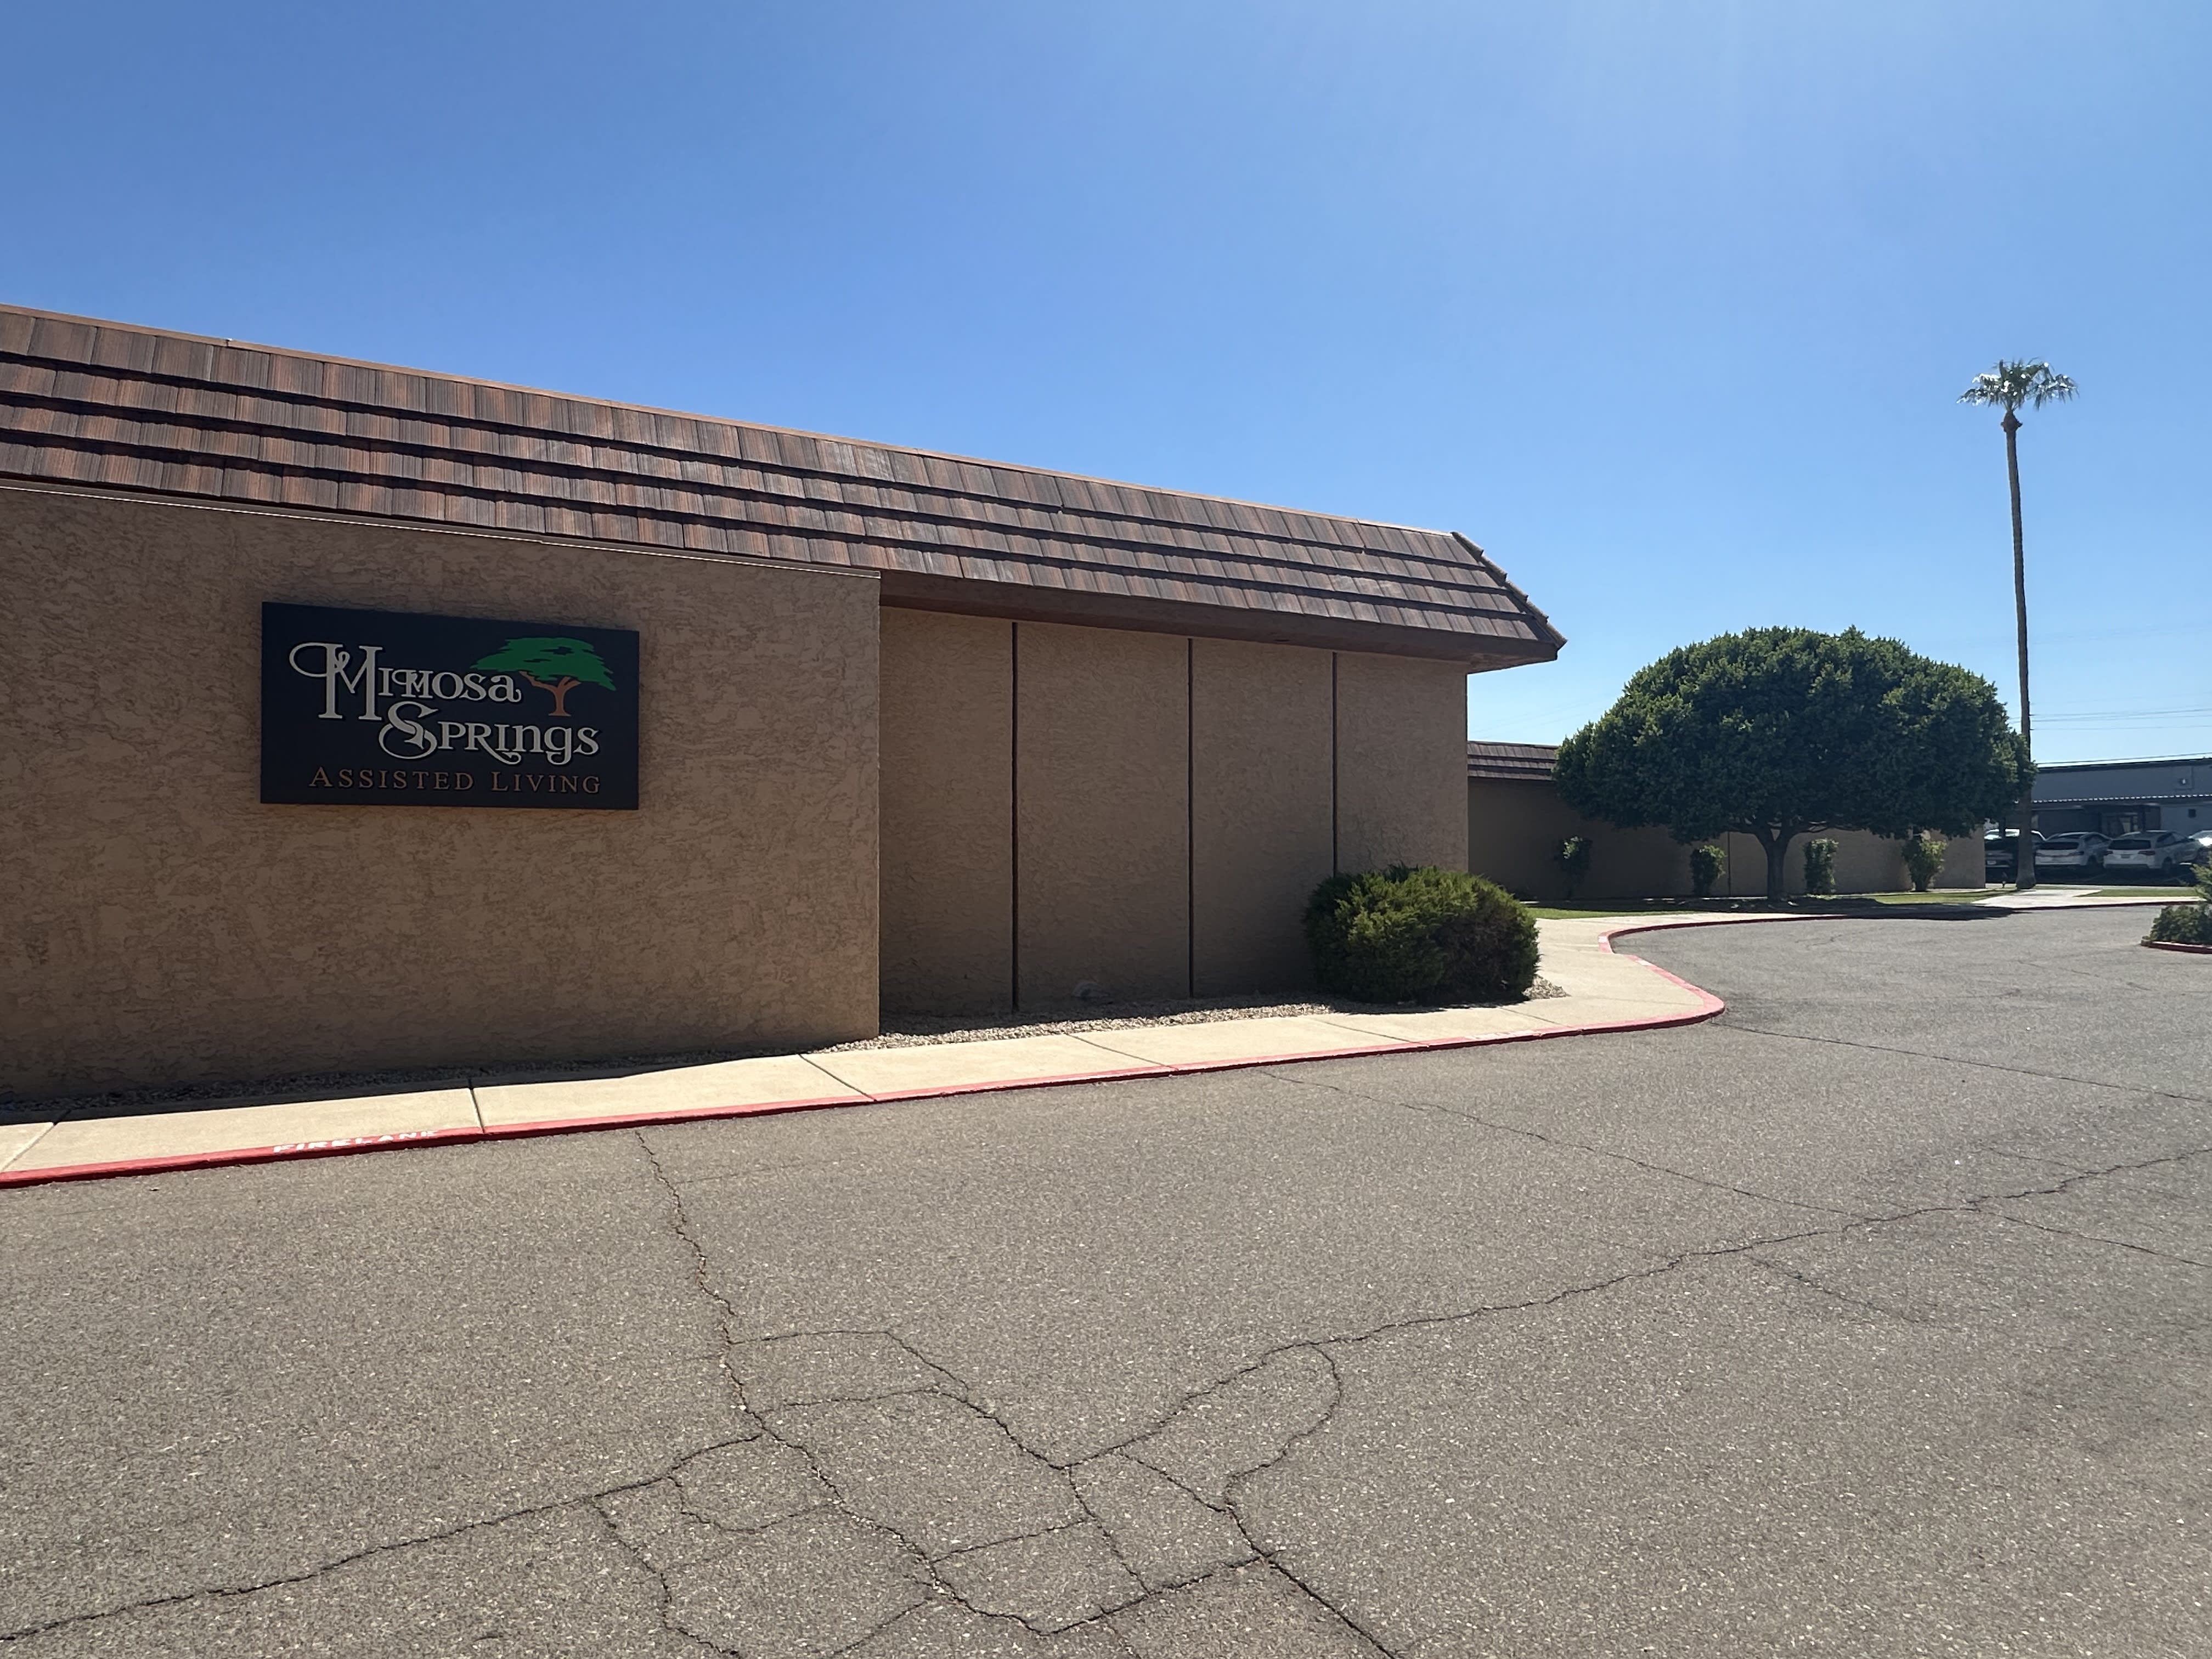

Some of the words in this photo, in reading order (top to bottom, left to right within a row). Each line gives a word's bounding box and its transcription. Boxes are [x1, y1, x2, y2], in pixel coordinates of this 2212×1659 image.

[309, 766, 474, 791] ASSISTED
[491, 771, 601, 794] LIVING
[273, 1139, 352, 1153] FIRE
[355, 1131, 438, 1144] LANE
